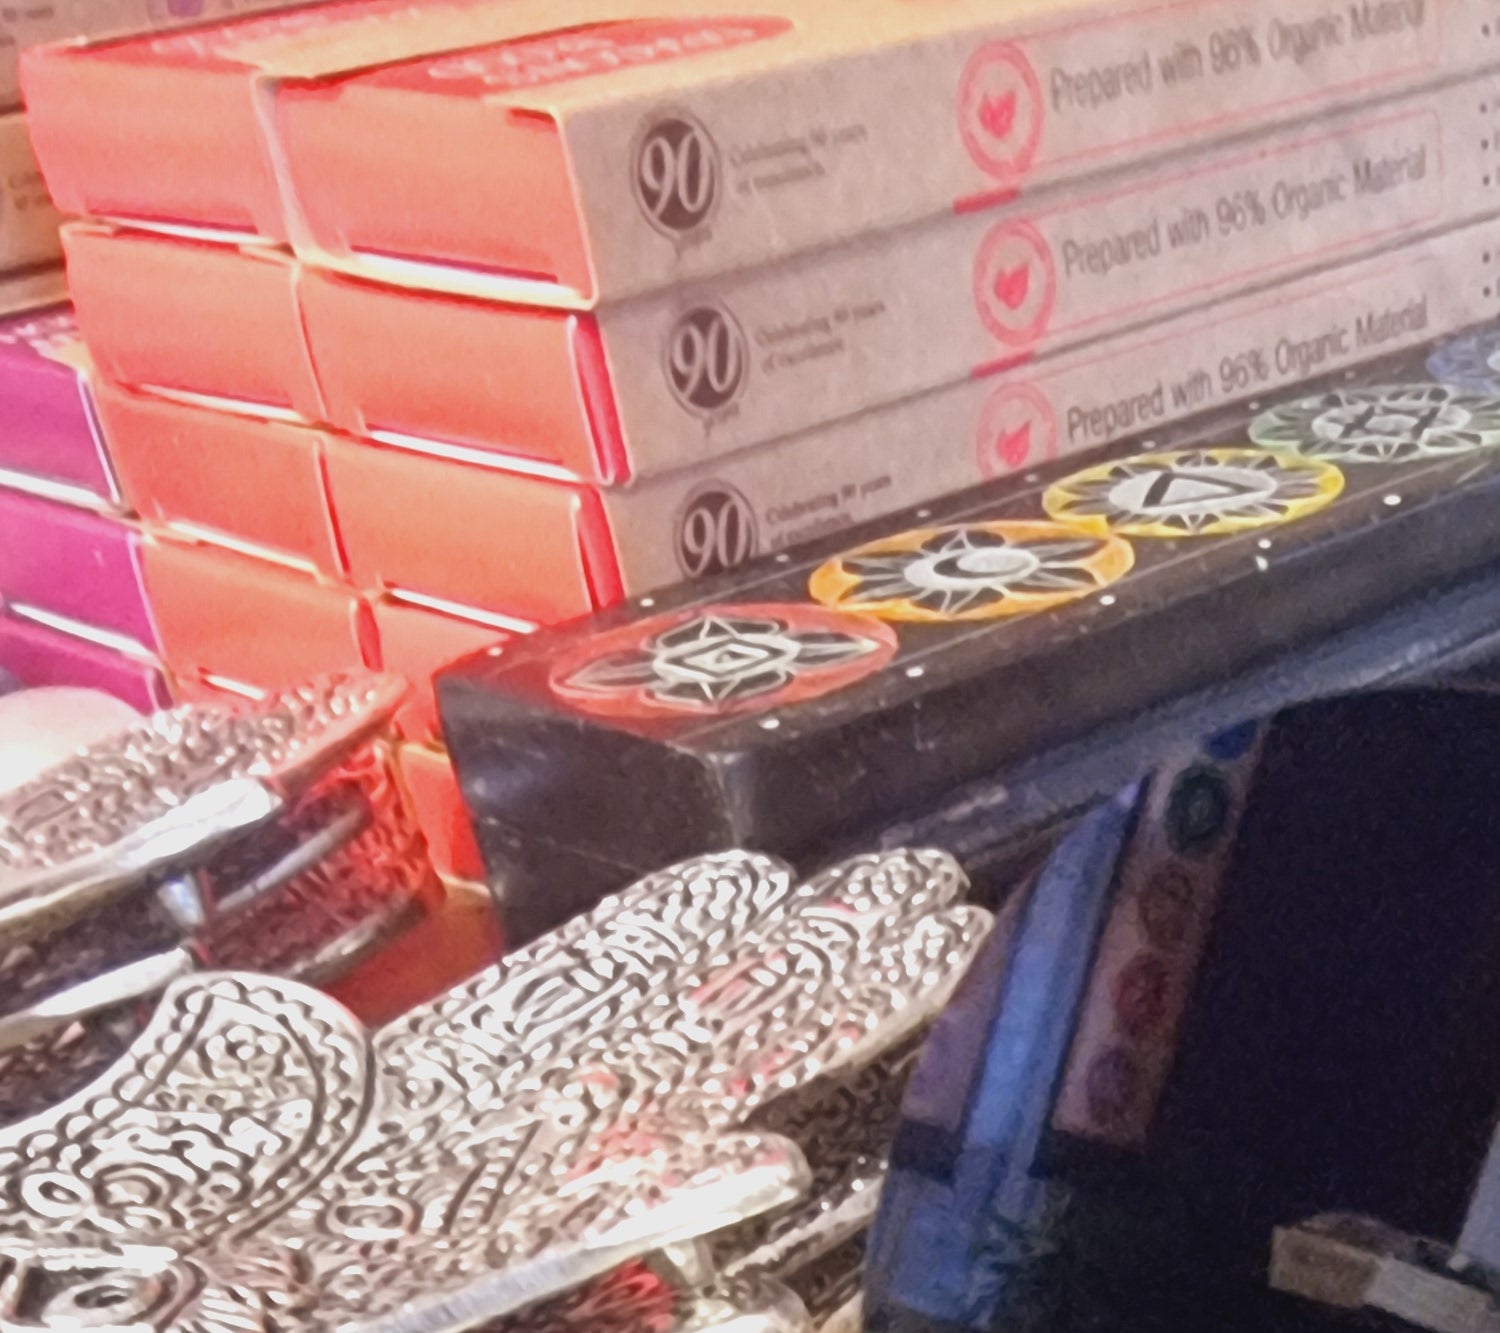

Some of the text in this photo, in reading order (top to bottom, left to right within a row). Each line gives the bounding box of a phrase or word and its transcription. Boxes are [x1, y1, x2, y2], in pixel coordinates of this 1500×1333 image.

[1050, 50, 1152, 111] Prepared
[1159, 41, 1201, 86] with
[1268, 13, 1343, 65] Organic
[641, 136, 711, 214] 90
[1062, 219, 1161, 278] Prepared
[1167, 208, 1210, 249] with
[1271, 174, 1345, 221] Organic
[1352, 145, 1426, 195] Material
[672, 324, 738, 394] 90
[1066, 295, 1428, 443] Prepared with 96% Organic Material
